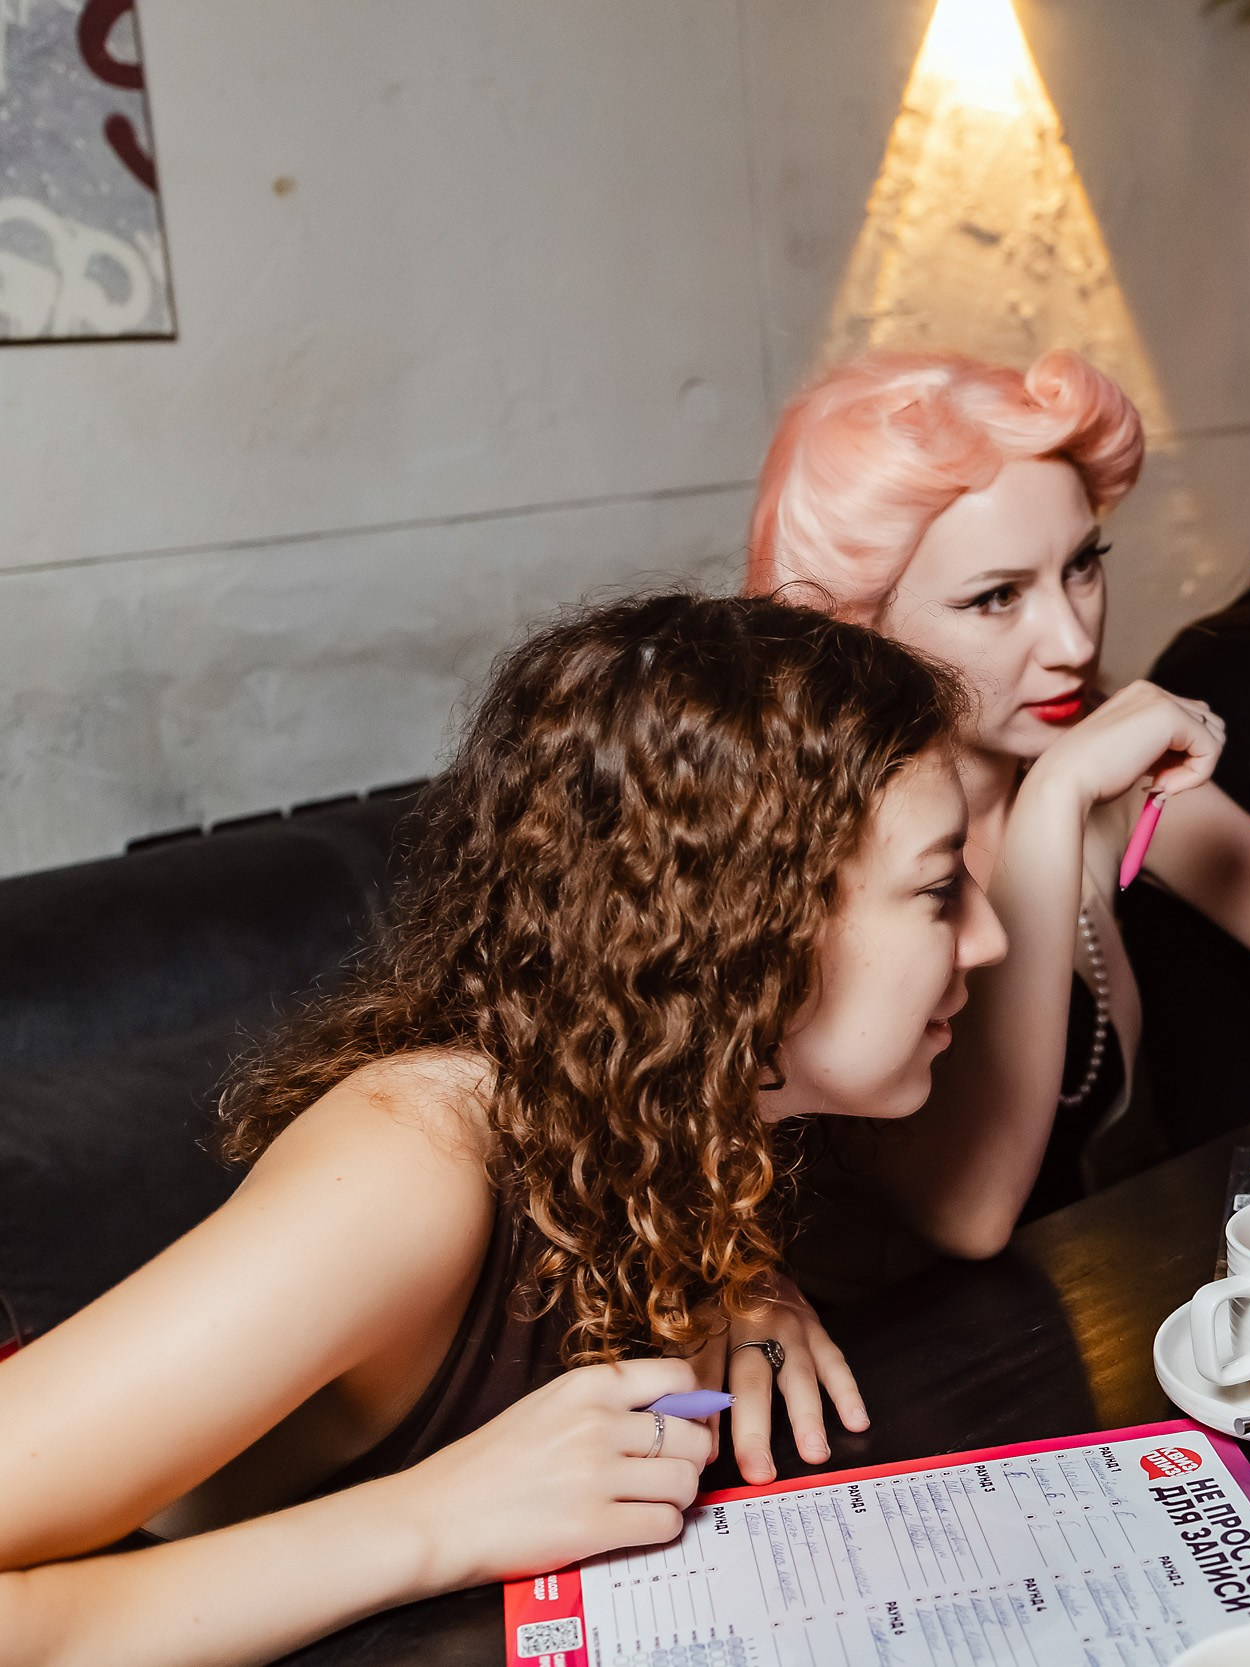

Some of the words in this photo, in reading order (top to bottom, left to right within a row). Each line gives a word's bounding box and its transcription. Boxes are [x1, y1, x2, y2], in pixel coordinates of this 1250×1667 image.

[1099, 1446, 1117, 1472] РАУНД
[974, 1464, 993, 1487] РАУНД
[847, 1484, 864, 1509] РАУНД
[1186, 1478, 1226, 1503] НЕ
[712, 1506, 728, 1530] РАУНД
[1149, 1485, 1203, 1526] ДЛЯ
[1158, 1555, 1181, 1581] РАУНД
[1023, 1578, 1044, 1606] РАУНД
[885, 1601, 904, 1630] РАУНД
